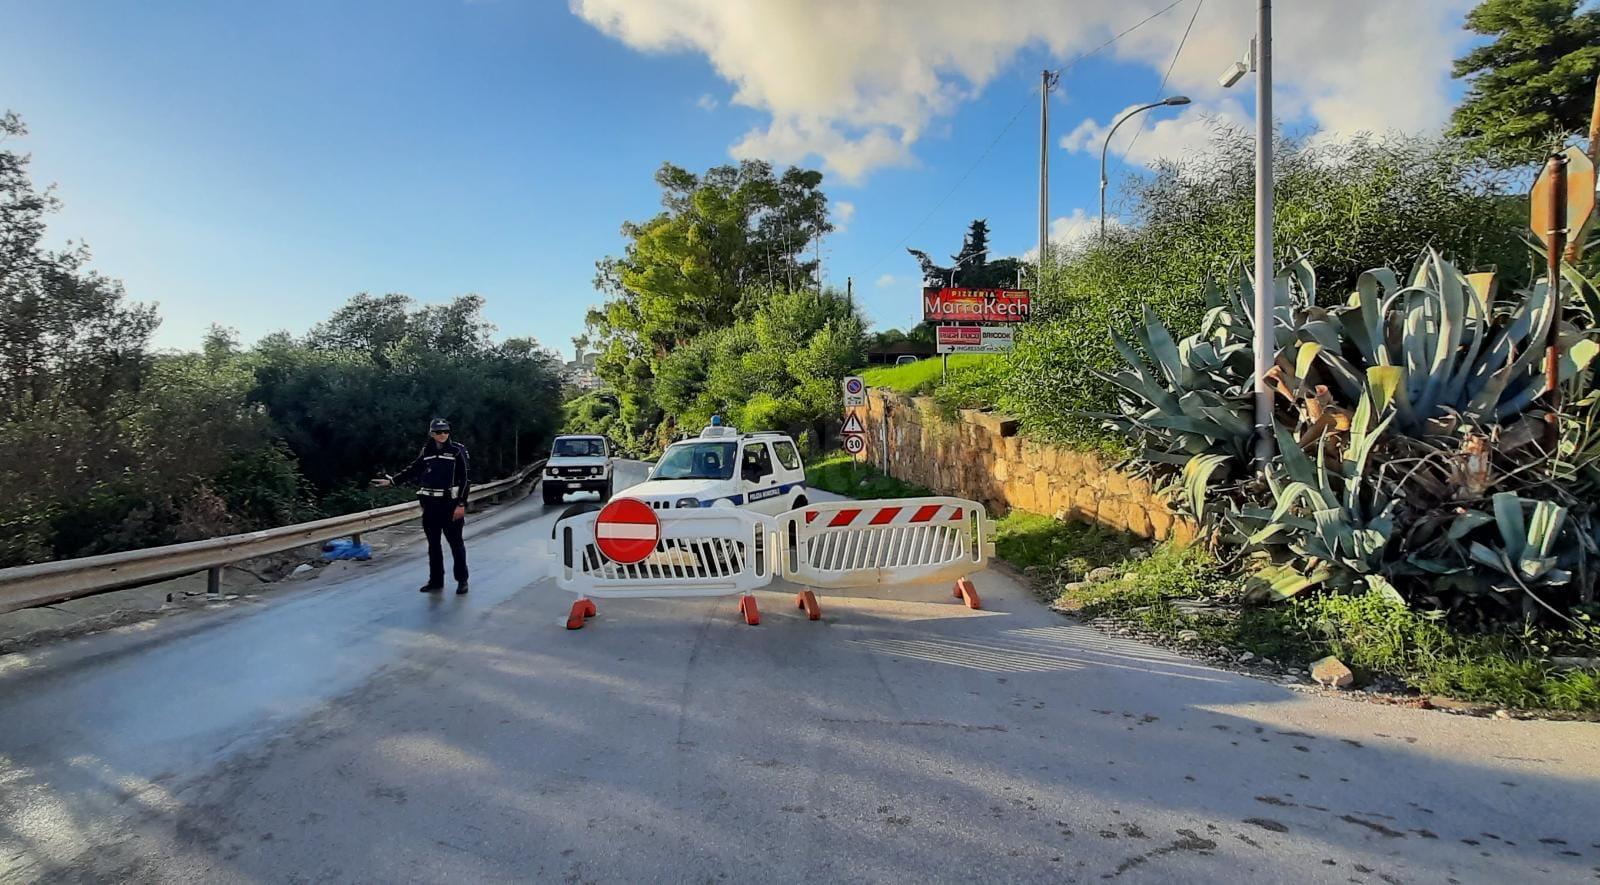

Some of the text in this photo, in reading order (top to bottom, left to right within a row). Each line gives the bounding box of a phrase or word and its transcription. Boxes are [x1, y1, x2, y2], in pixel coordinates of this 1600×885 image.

[951, 290, 996, 298] PIZZERIA
[925, 296, 1028, 315] MarraKech
[848, 440, 860, 449] 30
